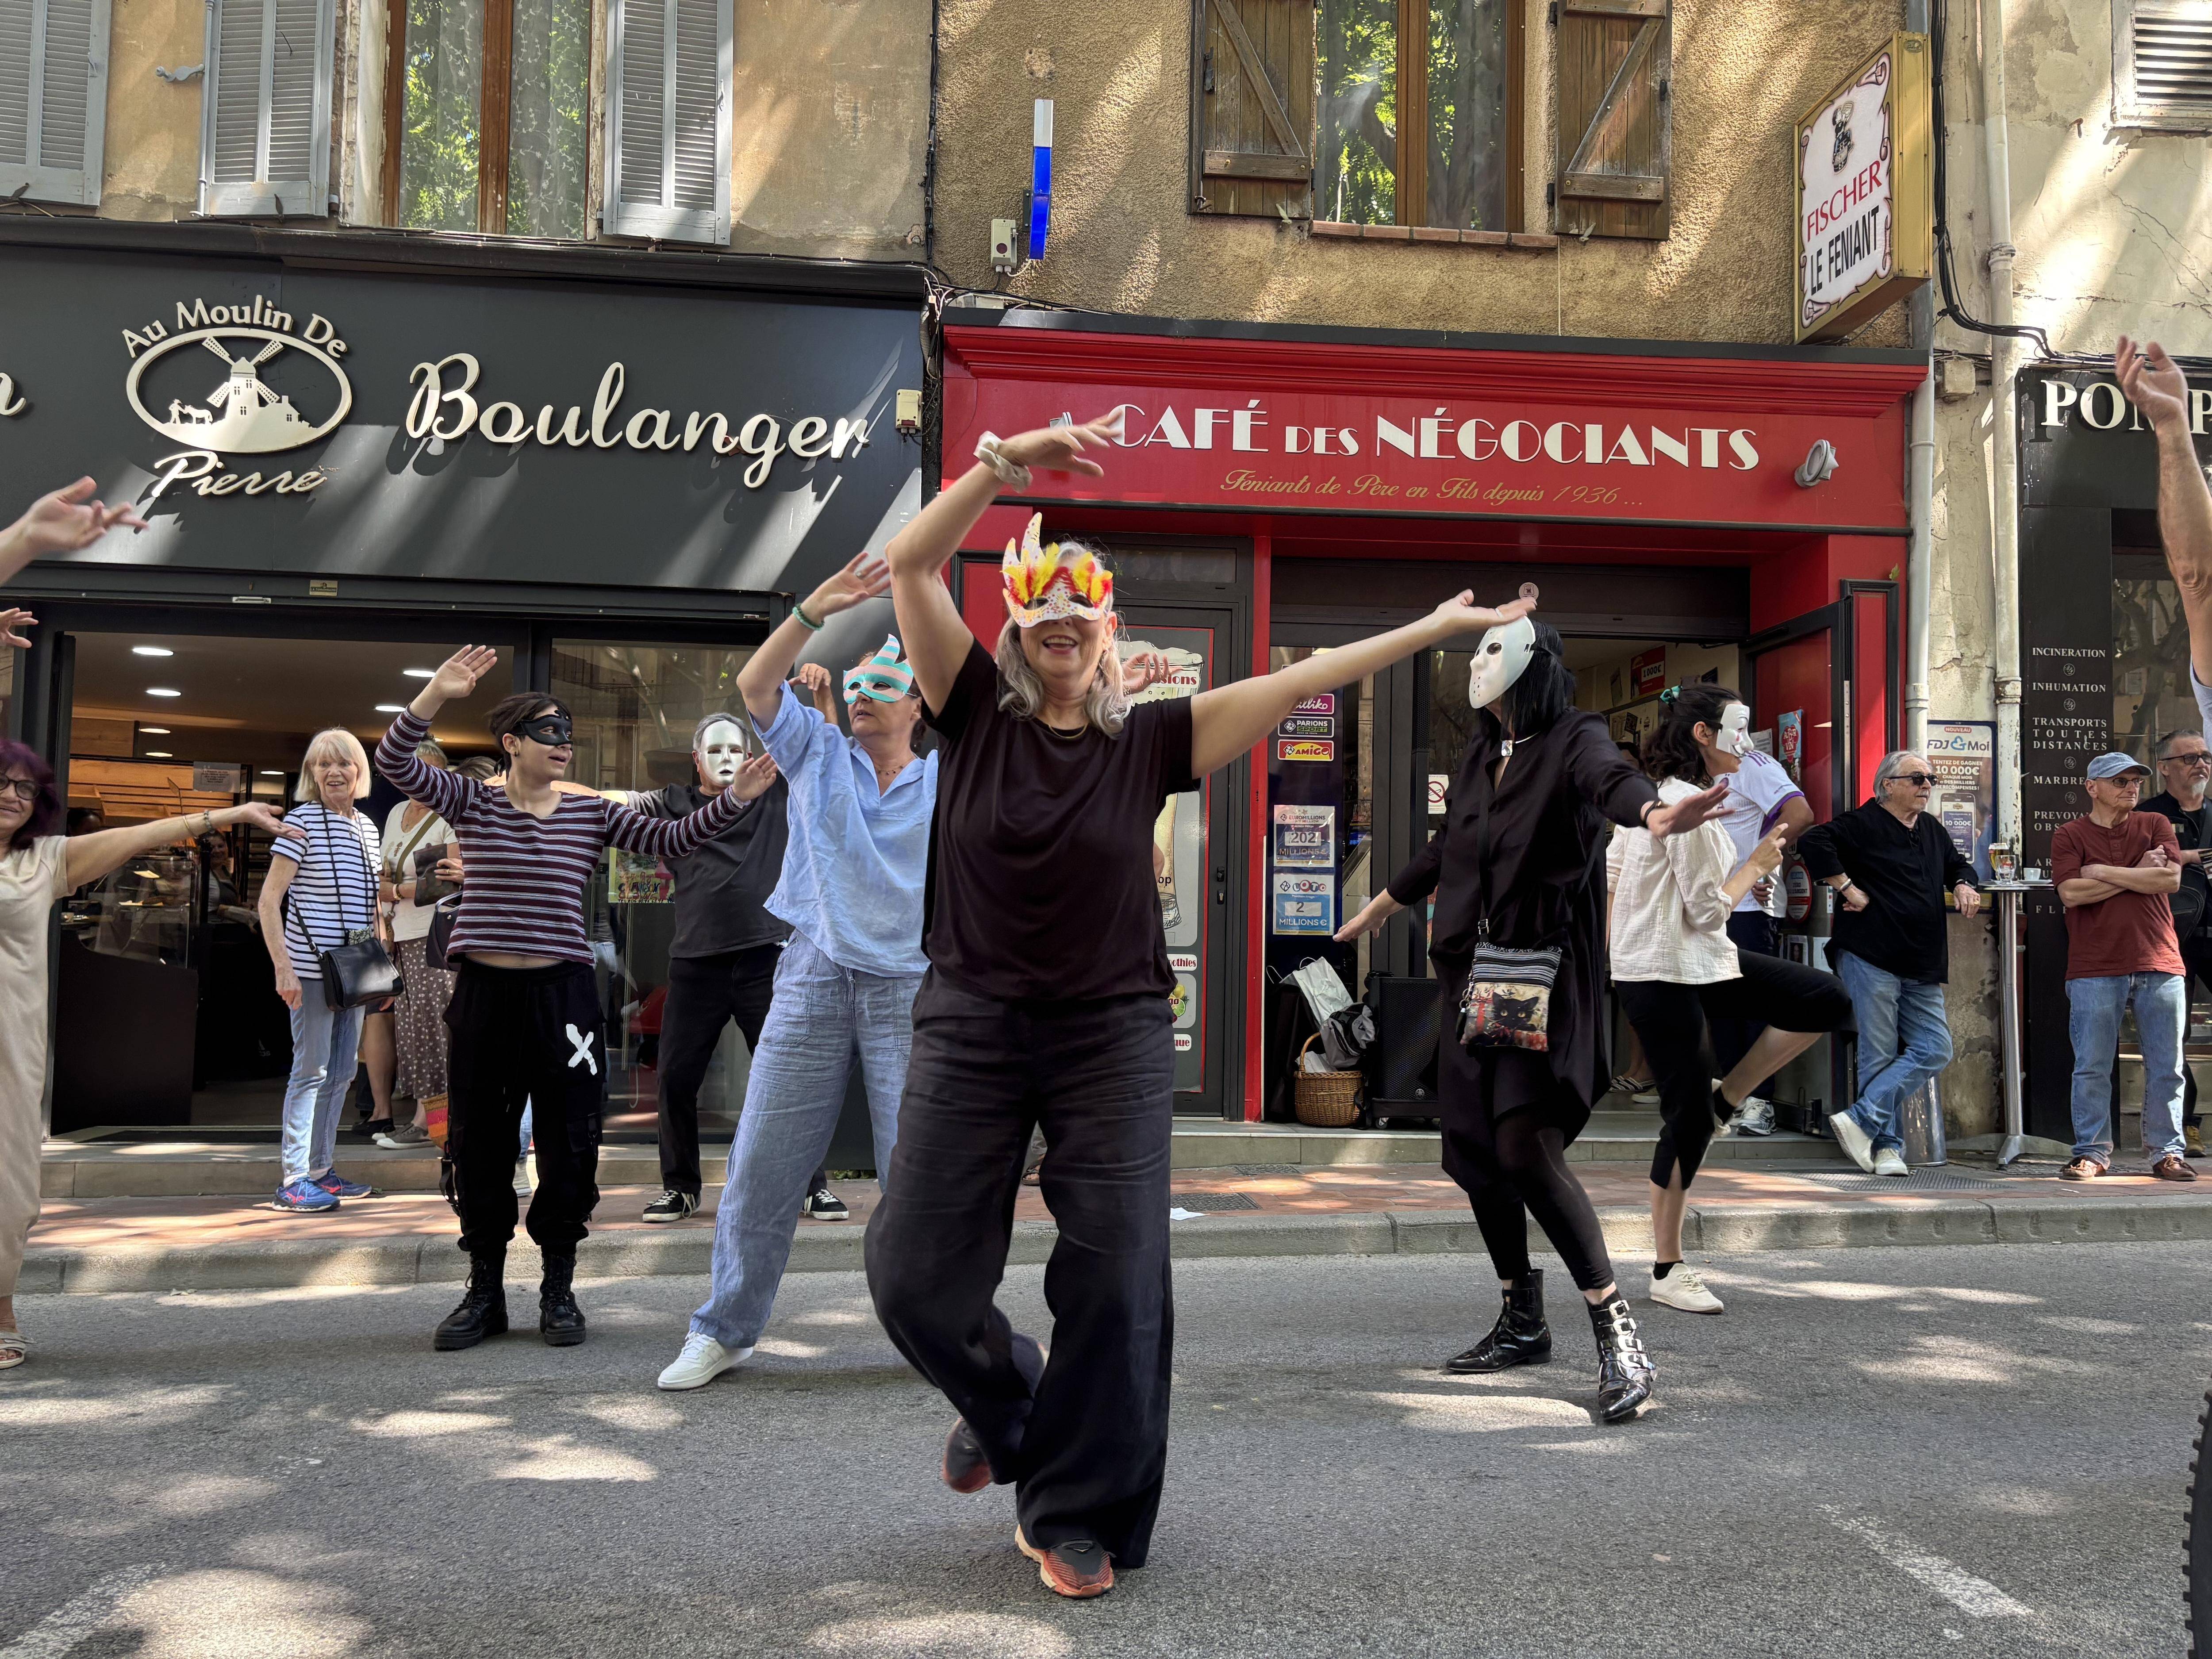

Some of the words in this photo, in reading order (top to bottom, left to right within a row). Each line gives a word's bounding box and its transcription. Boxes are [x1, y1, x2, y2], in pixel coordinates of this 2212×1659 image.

[1807, 160, 1883, 242] FISCHER
[1811, 247, 1823, 296] LE
[1828, 205, 1880, 283] FENIANT
[122, 320, 168, 358] Au
[176, 295, 294, 331] Moulin
[303, 313, 348, 358] De
[405, 353, 870, 488] Boulanger
[1109, 399, 1269, 452] CAFÉ
[1285, 426, 1359, 456] DES
[1376, 407, 1759, 470] NÉGOCIANTS
[152, 450, 327, 498] Pierre
[1220, 469, 1312, 494] Féniants
[1315, 476, 1341, 495] de
[1347, 474, 1400, 496] Père
[1406, 485, 1429, 498] en
[1436, 477, 1479, 499] Fils
[1483, 482, 1545, 507] depuis
[2032, 647, 2105, 658] INCINERATION
[2032, 682, 2106, 693] INHUMATION
[2032, 717, 2107, 727] TRANSPORTS
[2033, 729, 2107, 739] TOUTES
[1927, 739, 1950, 749] FDJ
[1967, 741, 1990, 751] Moi
[2033, 741, 2107, 750] DISTANCES
[1936, 765, 1948, 774] 10
[1950, 766, 1979, 776] 000€
[2034, 776, 2085, 785] MARBRE
[2034, 810, 2089, 820] PREVOYA
[1291, 832, 1316, 843] 202
[1158, 876, 1171, 886] op
[1292, 879, 1327, 892] LOTO
[1296, 902, 1305, 913] 2
